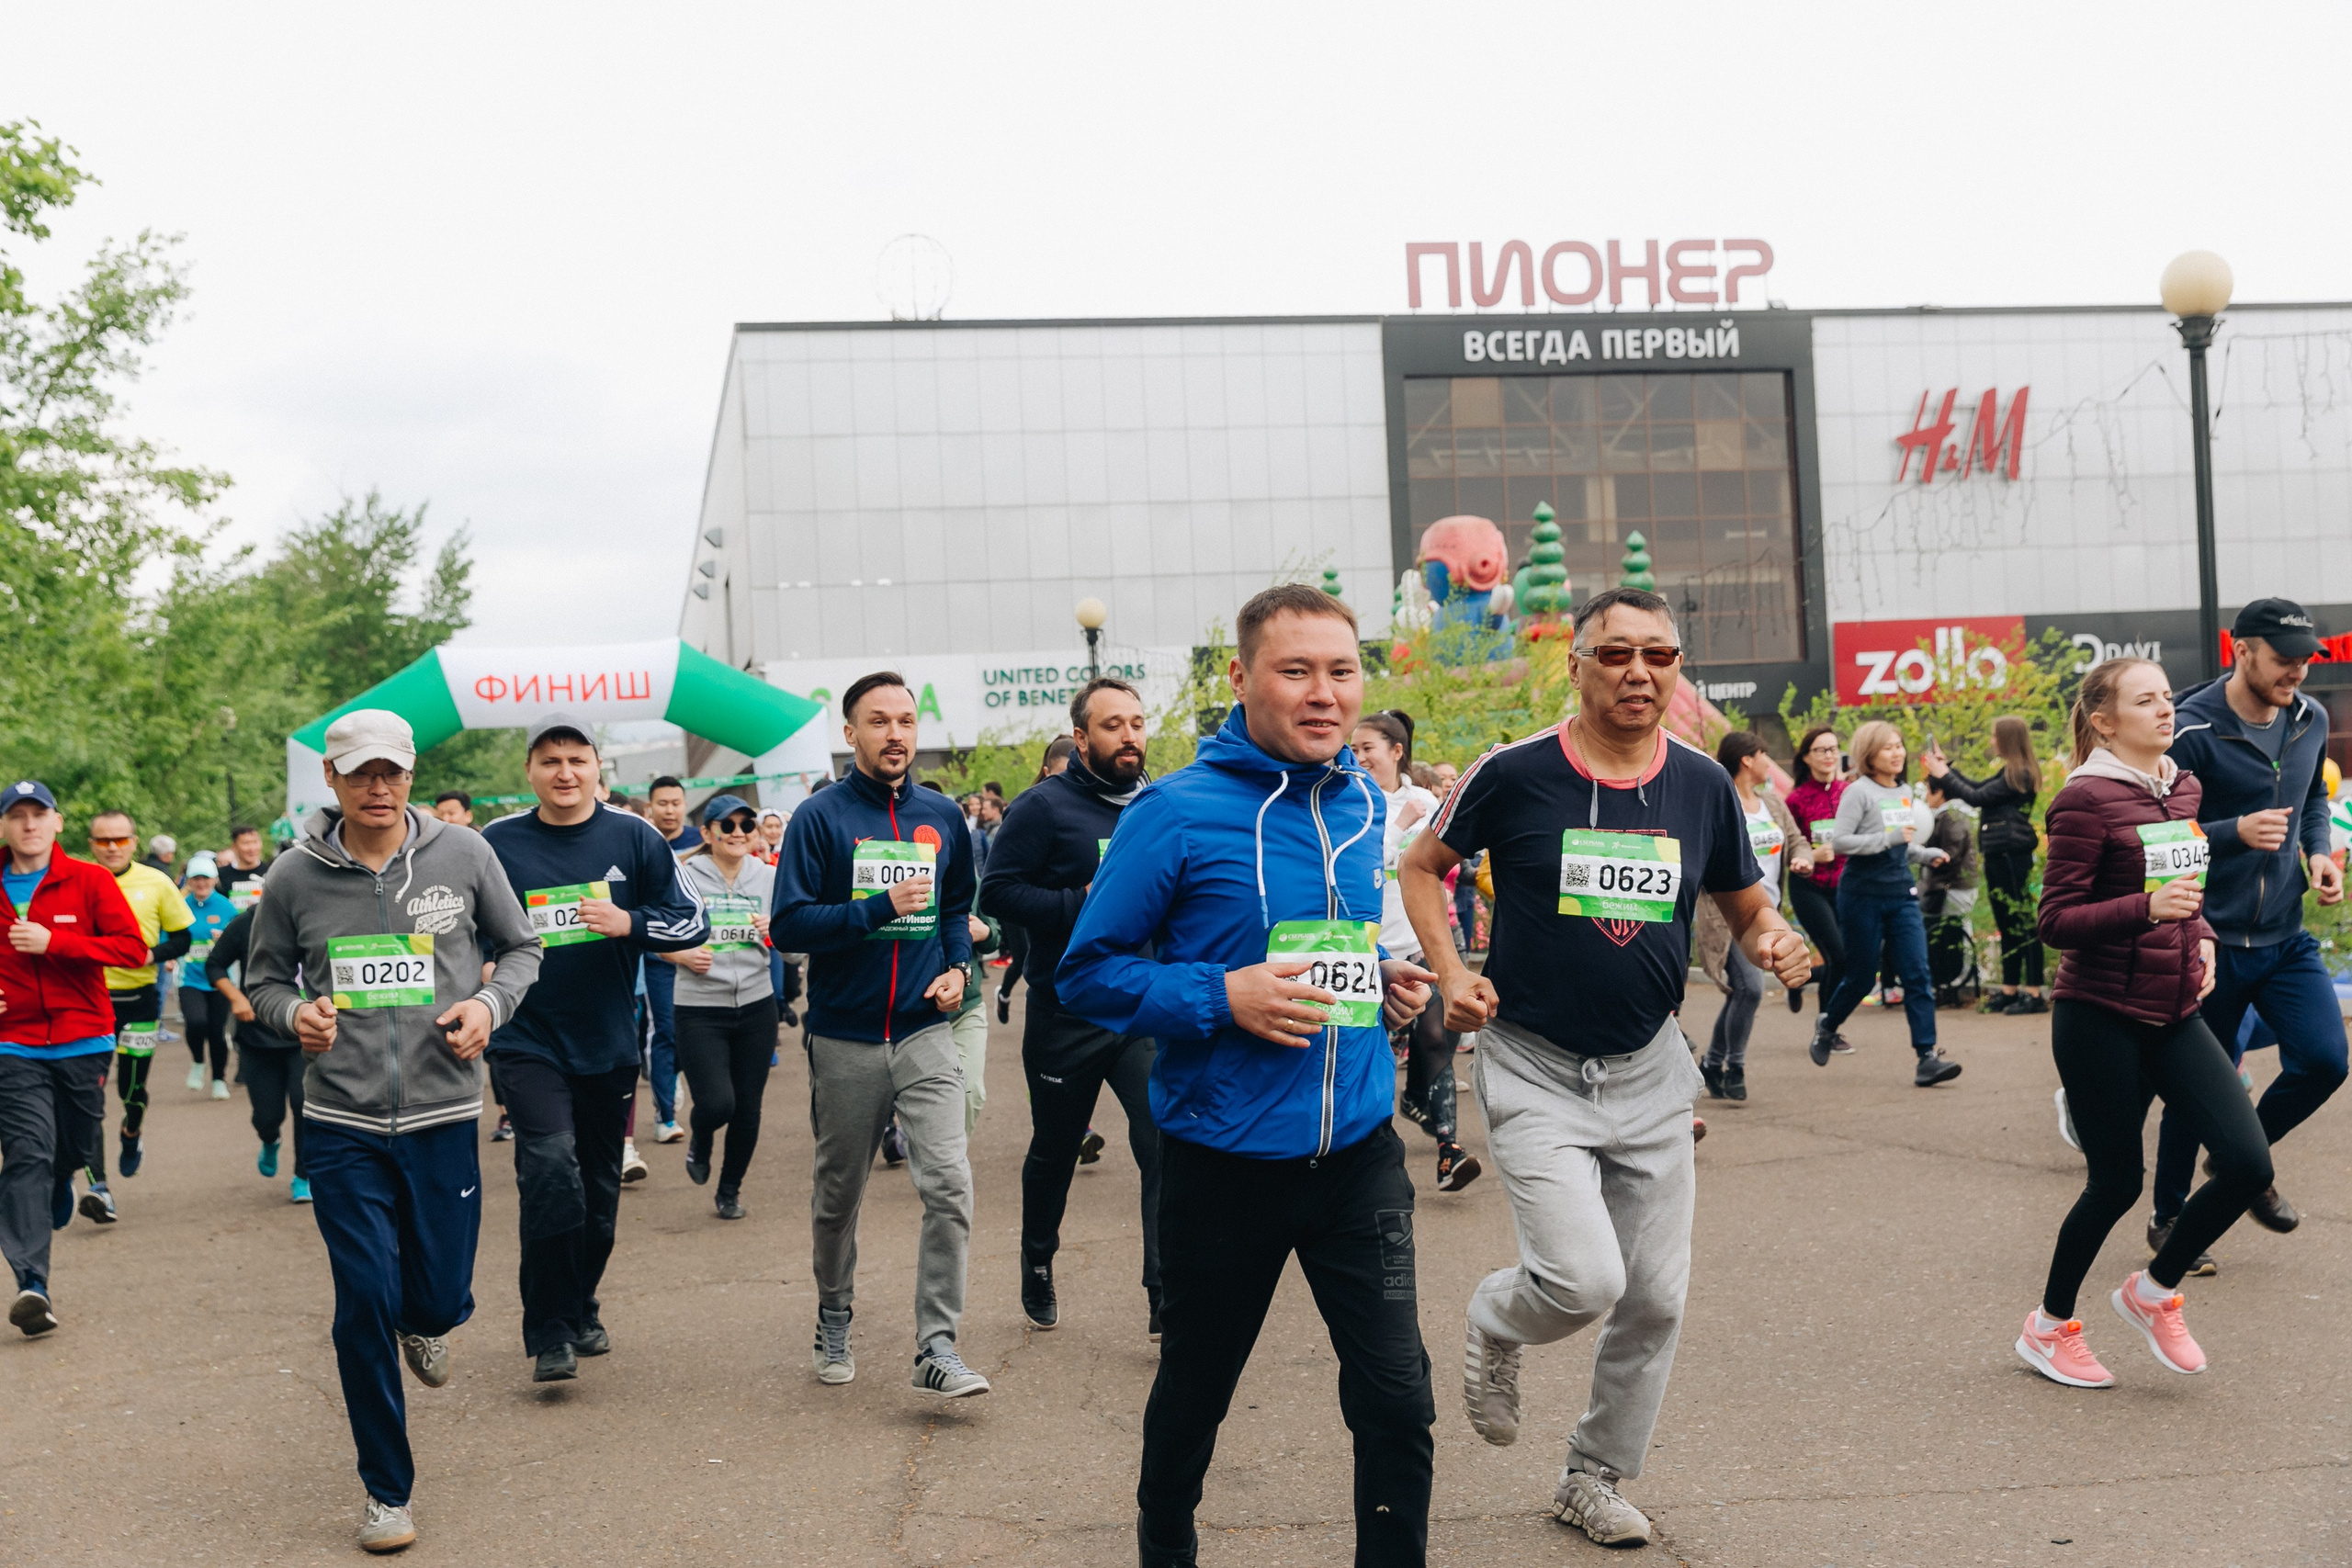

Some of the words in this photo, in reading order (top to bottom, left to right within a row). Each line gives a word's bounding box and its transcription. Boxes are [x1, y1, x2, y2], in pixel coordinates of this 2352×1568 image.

[1406, 239, 1774, 309] ПИОНЕР
[1464, 329, 1592, 365] ВСЕГДА
[1601, 319, 1740, 360] ПЕРВЫЙ
[1895, 386, 2029, 484] H&M
[474, 671, 650, 704] ФИНИШ
[984, 668, 1059, 685] UNITED
[1066, 663, 1146, 682] COLORS
[985, 690, 1011, 707] OF
[1599, 863, 1672, 896] 0623
[720, 929, 755, 941] 0616
[362, 961, 425, 985] 0202
[1310, 960, 1377, 994] 0624
